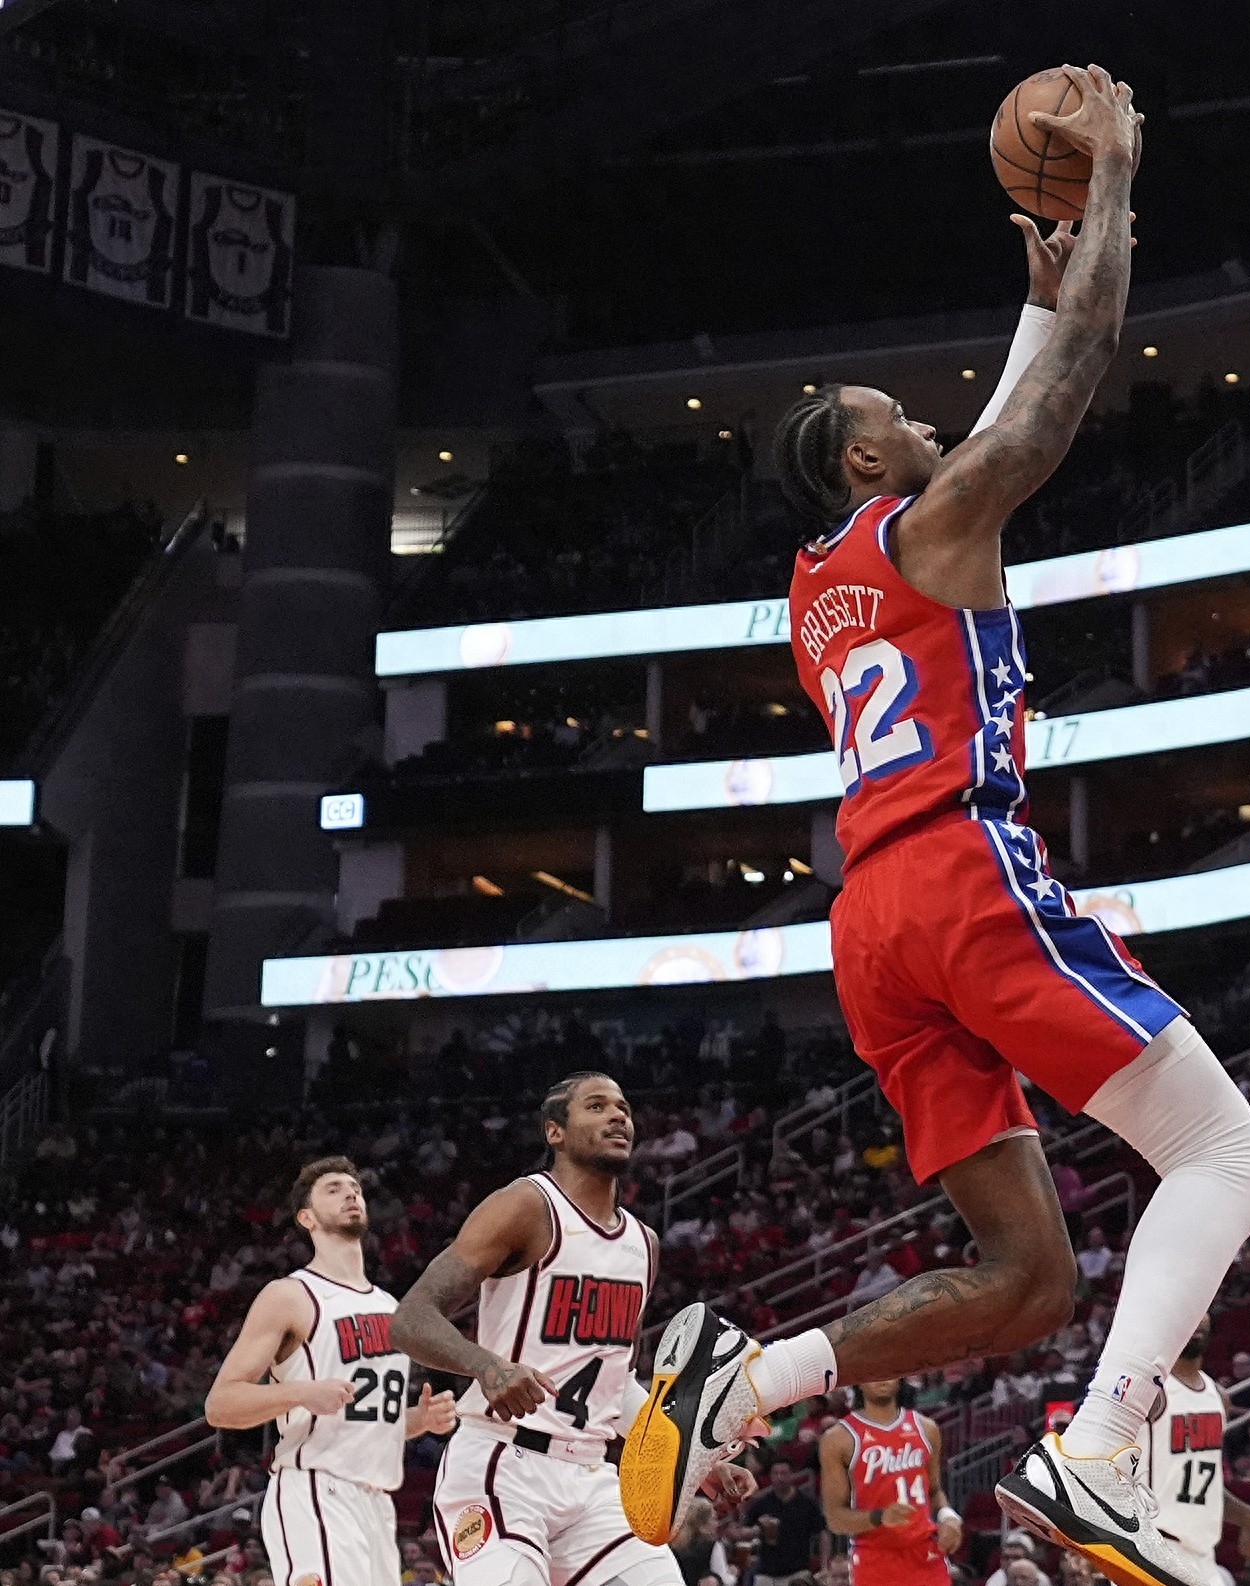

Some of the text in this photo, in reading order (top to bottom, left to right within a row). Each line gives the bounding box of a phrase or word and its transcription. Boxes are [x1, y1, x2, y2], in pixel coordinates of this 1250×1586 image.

[800, 585, 885, 665] BRISSETT
[820, 638, 935, 798] 22
[1043, 720, 1080, 759] 17
[345, 1367, 405, 1424] 28
[555, 1355, 604, 1432] 4
[862, 1442, 924, 1484] Phila
[1176, 1460, 1216, 1505] 17
[896, 1474, 926, 1505] 14
